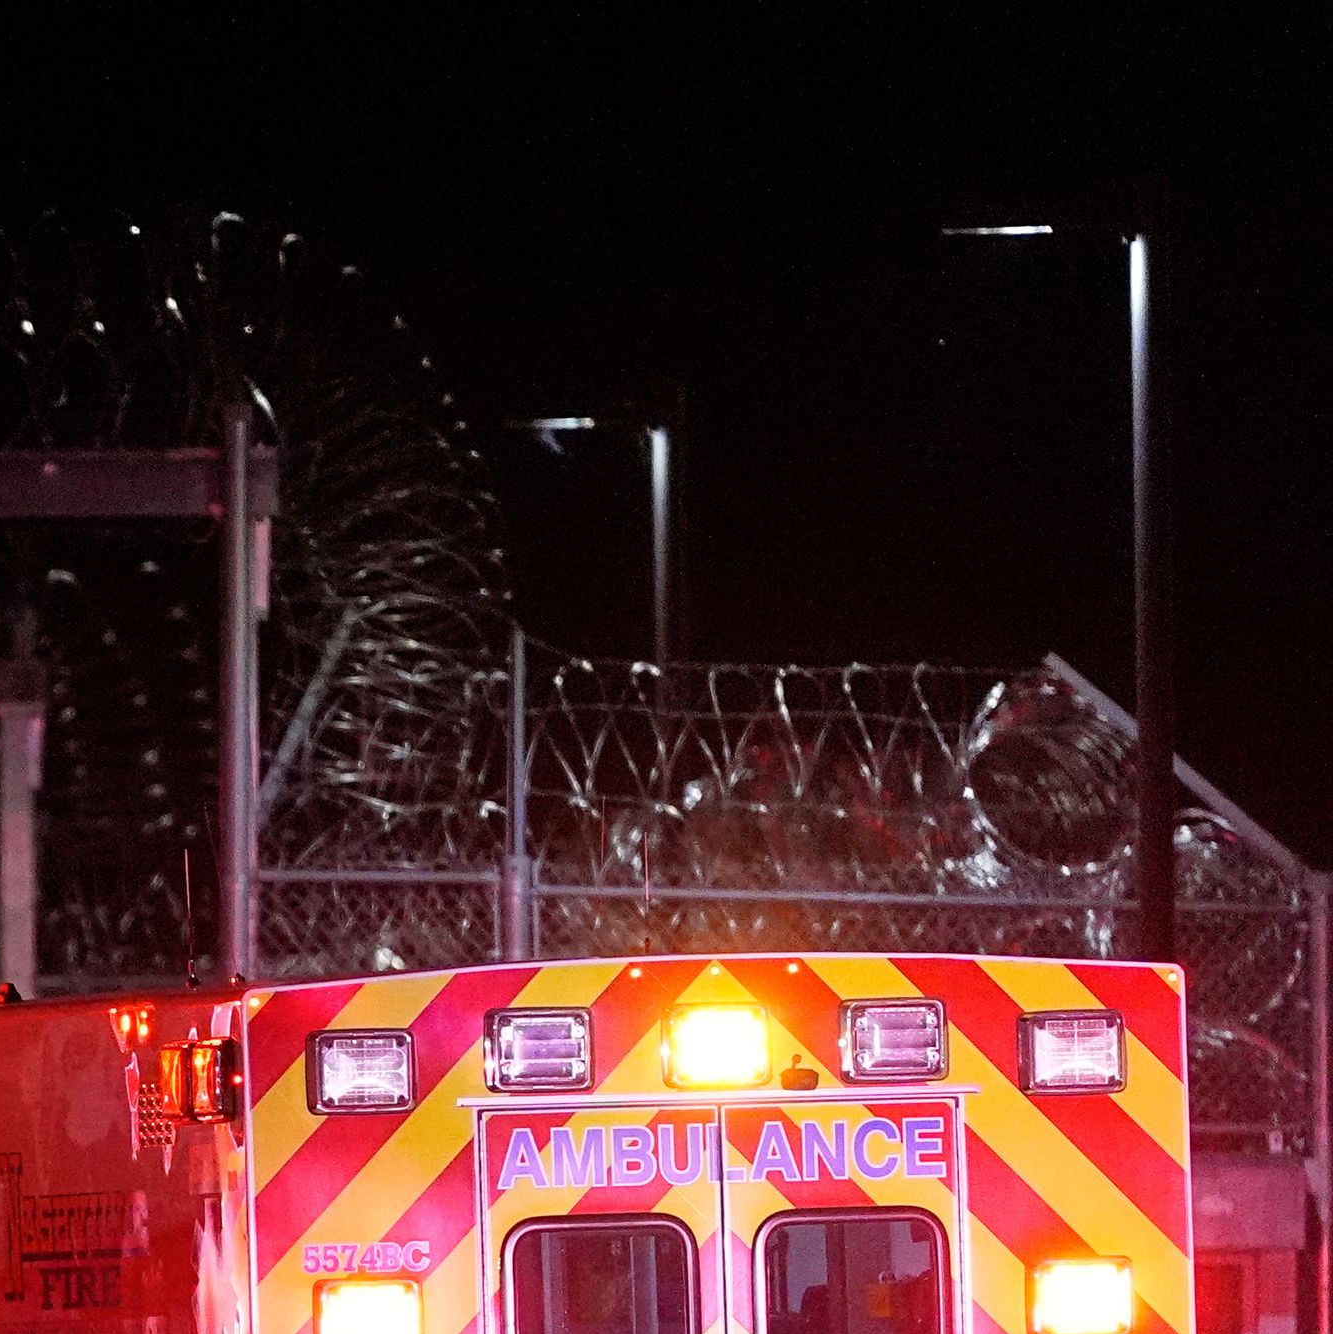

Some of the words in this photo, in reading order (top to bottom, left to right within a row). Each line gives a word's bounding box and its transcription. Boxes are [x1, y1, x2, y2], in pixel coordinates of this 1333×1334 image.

[497, 1117, 947, 1190] AMBULANCE
[303, 1241, 431, 1274] 5574BC
[40, 1265, 121, 1310] FIRE
